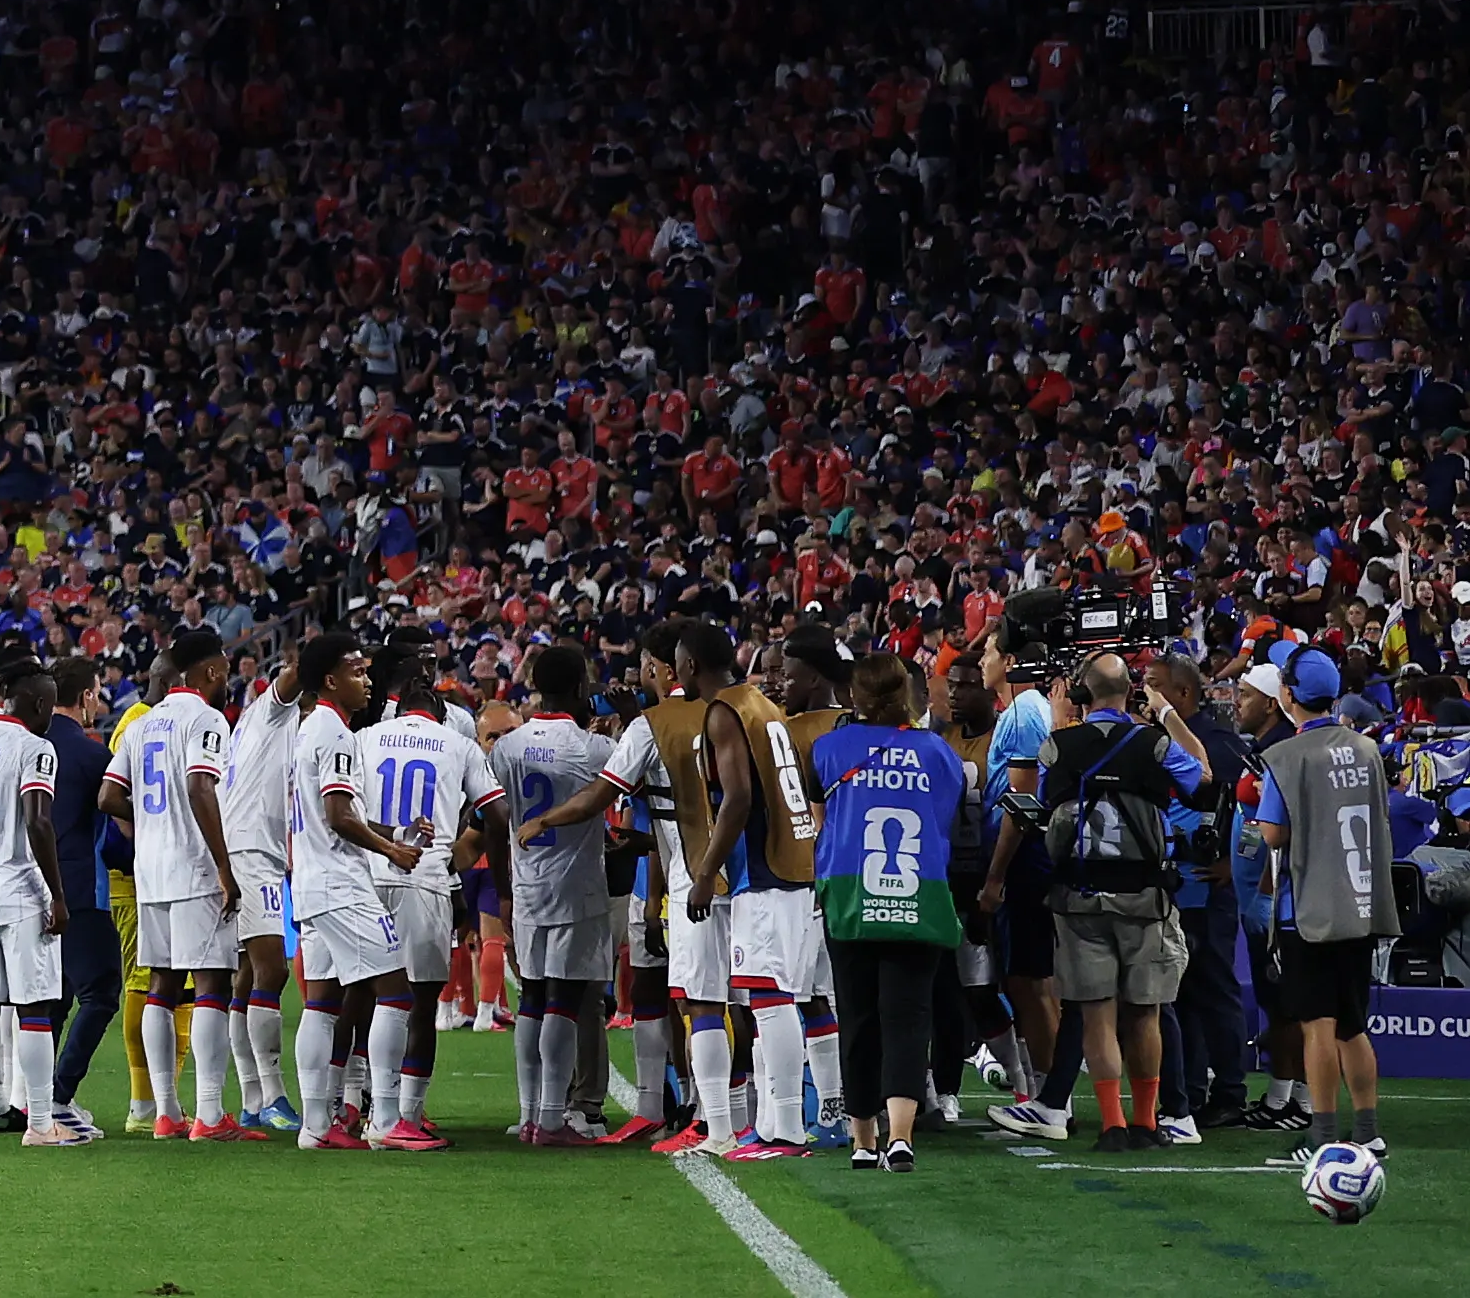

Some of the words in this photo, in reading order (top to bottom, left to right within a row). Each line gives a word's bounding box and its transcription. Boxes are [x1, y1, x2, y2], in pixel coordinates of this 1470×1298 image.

[1048, 48, 1062, 68] 4
[379, 734, 447, 753] BELLEGARDE
[524, 746, 556, 764] ARCUS
[1328, 746, 1356, 767] HB
[143, 741, 167, 815] 5
[852, 768, 930, 793] PHOTO
[1327, 766, 1370, 790] 1135
[376, 757, 437, 827] 10
[522, 772, 557, 847] 2
[878, 877, 905, 889] FIFA
[862, 898, 898, 910] WORLD
[899, 899, 918, 910] CUP
[861, 908, 920, 925] 2026
[1367, 1014, 1437, 1037] ORLD
[1440, 1016, 1470, 1038] CU
